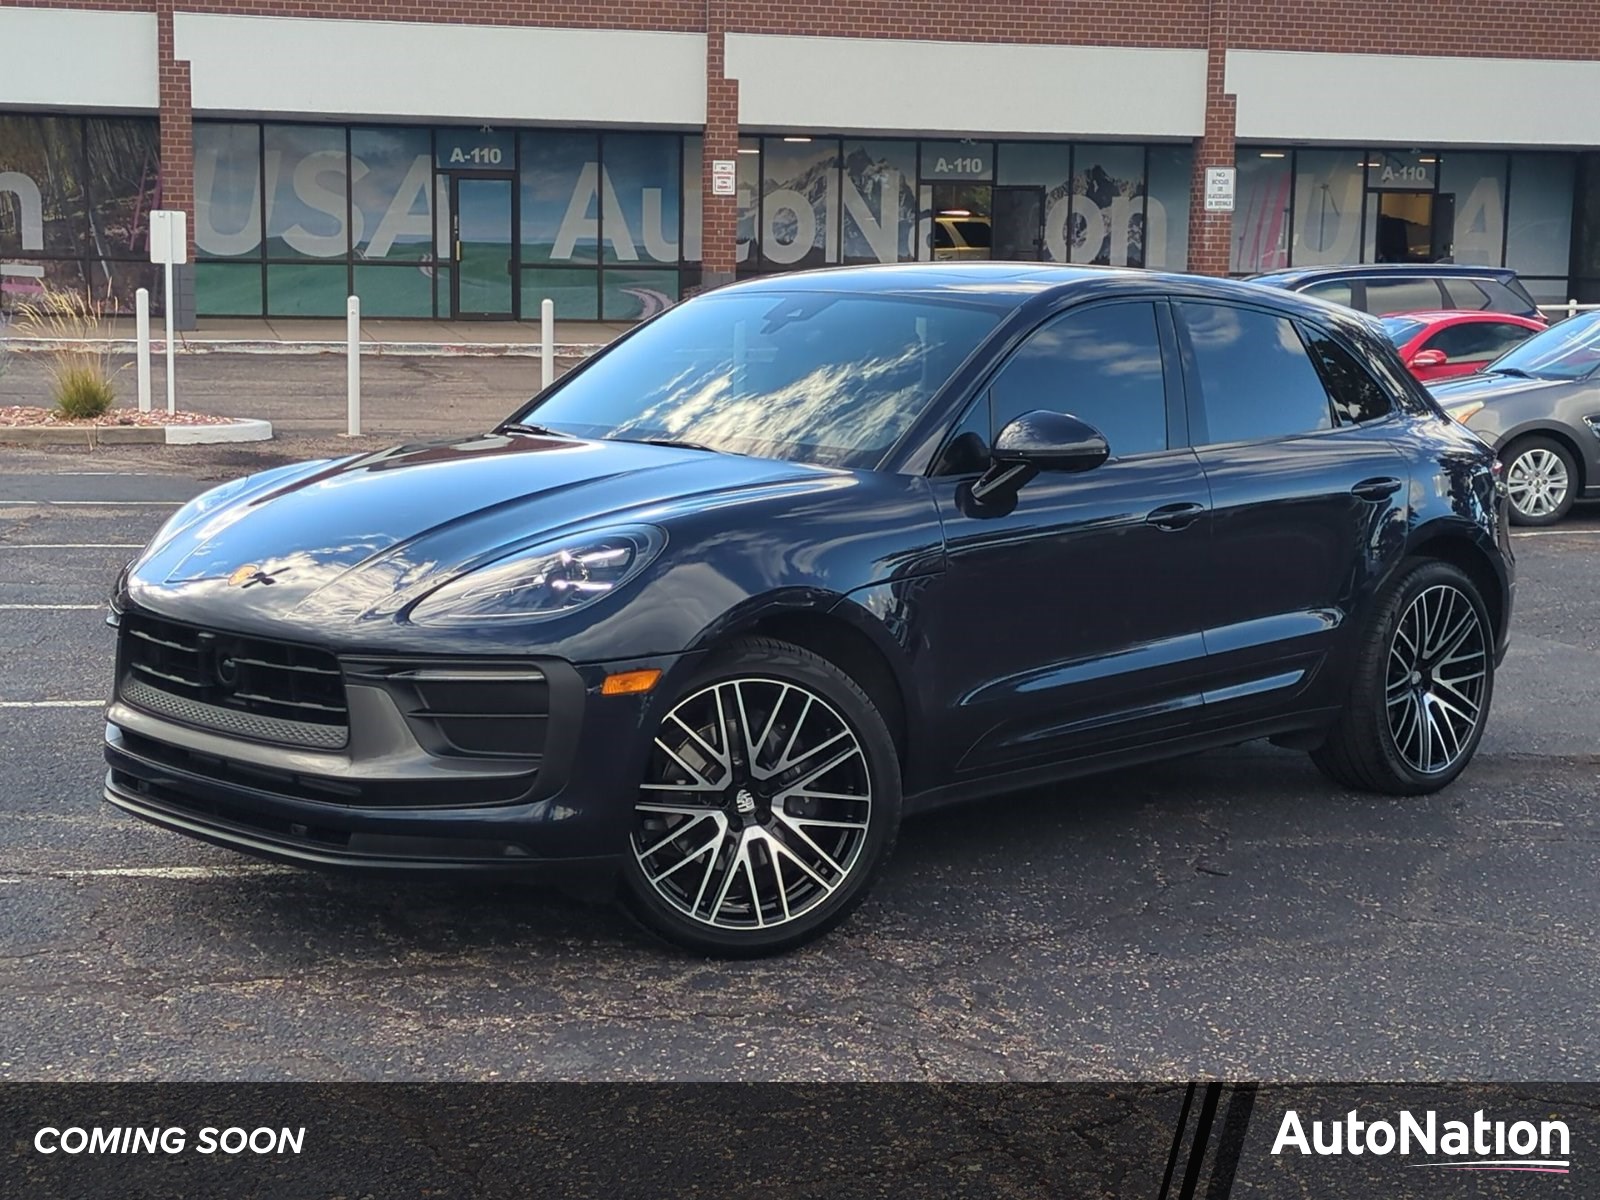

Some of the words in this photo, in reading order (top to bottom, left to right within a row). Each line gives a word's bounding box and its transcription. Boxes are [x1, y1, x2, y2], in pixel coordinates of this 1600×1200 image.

[450, 147, 502, 164] A-110
[935, 157, 983, 173] A-110
[1381, 166, 1426, 181] A-110
[193, 149, 451, 258] USA
[1288, 173, 1504, 268] UA
